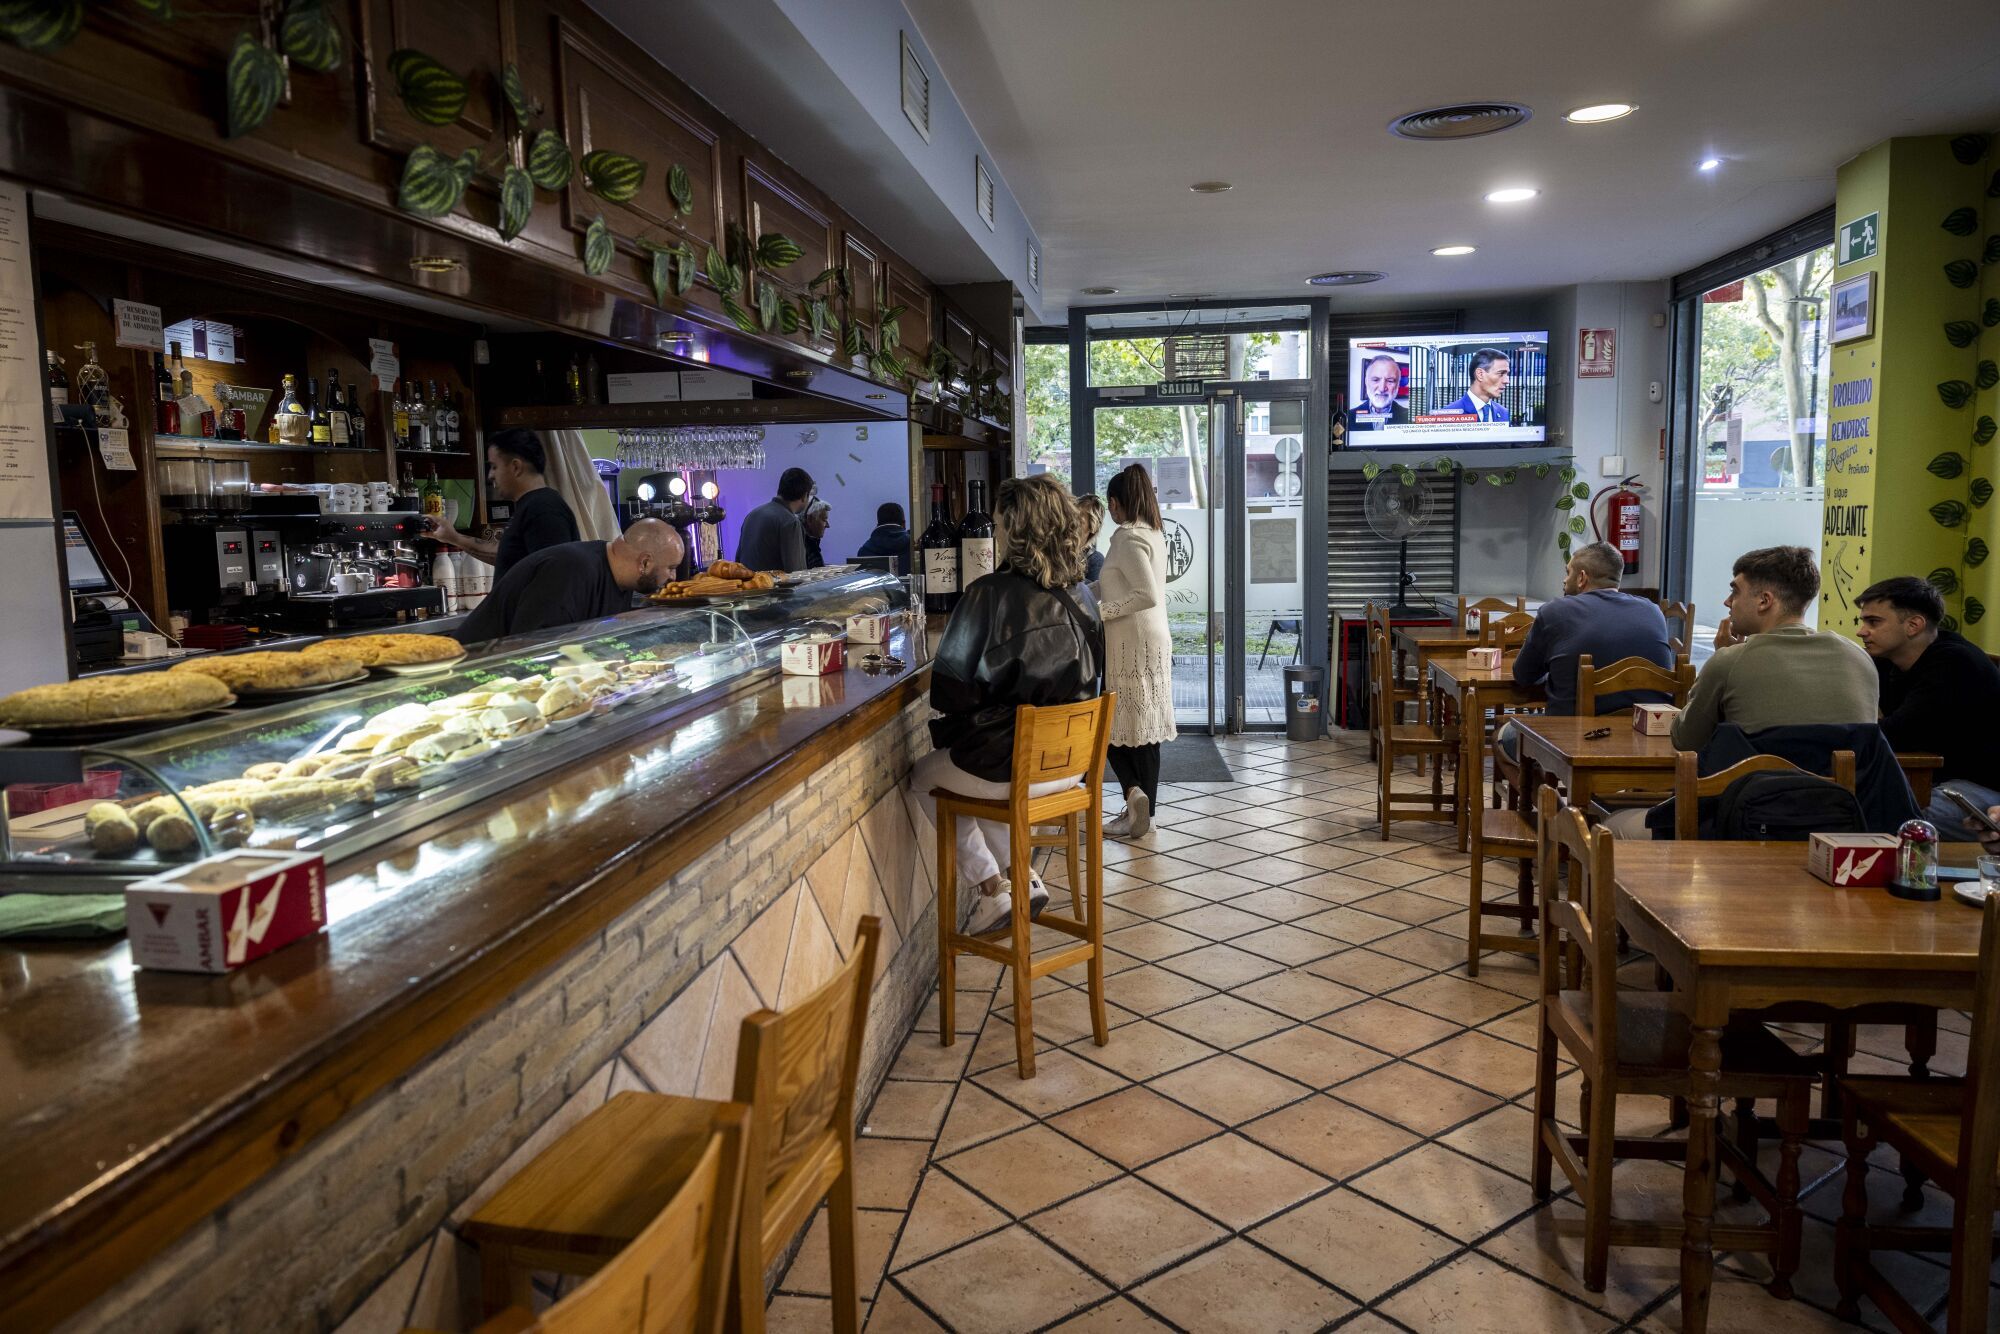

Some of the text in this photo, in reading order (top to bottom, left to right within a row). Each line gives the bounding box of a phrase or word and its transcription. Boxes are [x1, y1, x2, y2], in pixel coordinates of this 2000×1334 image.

[126, 304, 160, 318] RESERVADO
[122, 320, 130, 328] DE
[132, 313, 160, 325] DERECHO
[1161, 383, 1200, 395] SALIDA
[1833, 377, 1873, 409] PROHIBIDO
[856, 426, 868, 441] 3
[1831, 416, 1870, 442] RENDIRSE
[1826, 444, 1858, 474] Respira
[1848, 464, 1870, 475] Profundo
[1834, 487, 1848, 501] sigue
[1824, 505, 1869, 537] ADELANTE
[308, 867, 321, 922] AMBAR
[195, 907, 213, 971] AMBAR
